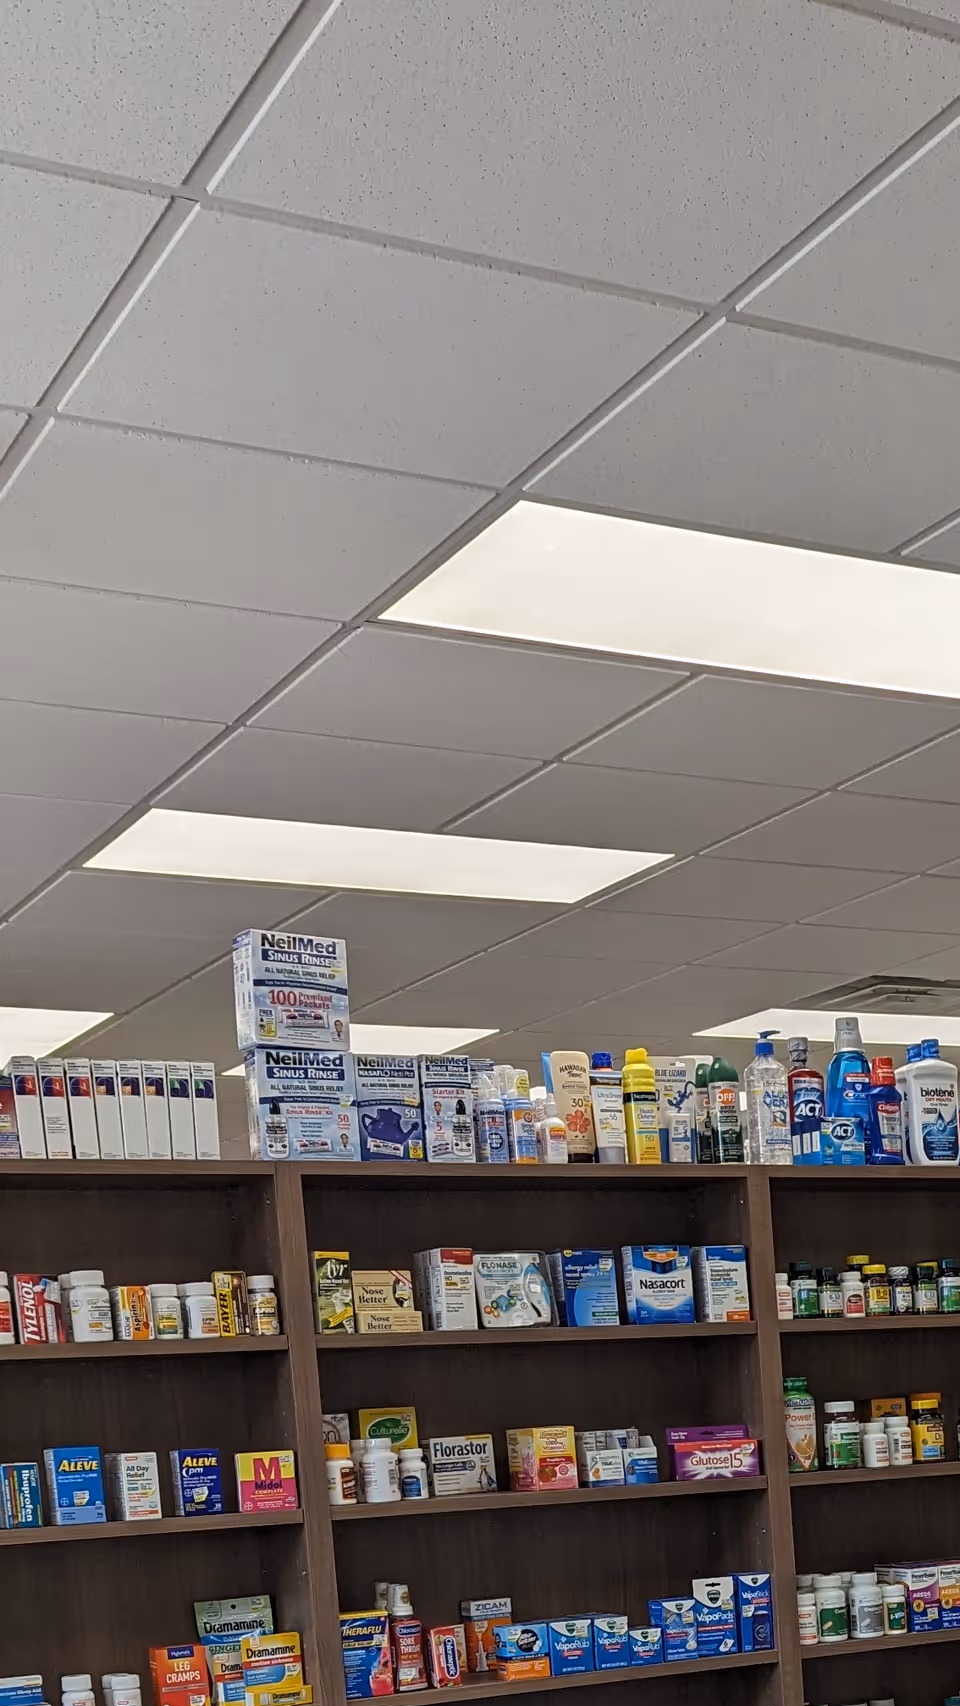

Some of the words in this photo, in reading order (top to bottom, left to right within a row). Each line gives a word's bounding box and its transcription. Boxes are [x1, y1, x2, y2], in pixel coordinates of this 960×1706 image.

[261, 934, 336, 955] NeilMed
[268, 951, 298, 963] SINUS
[301, 954, 331, 967] RINSE
[268, 990, 297, 1006] 100
[299, 992, 332, 1003] Premixed
[299, 1000, 330, 1009] Packets
[265, 1051, 344, 1067] NeilMed
[357, 1056, 414, 1068] NeilMed
[425, 1056, 468, 1066] NeilMed
[273, 1068, 305, 1079] SINUS
[308, 1069, 339, 1079] RINSE
[359, 1069, 390, 1078] NASAFLO
[560, 1064, 586, 1073] HAWAIIAN
[655, 1069, 667, 1077] BLUE
[669, 1069, 687, 1078] LIZARD
[716, 1092, 735, 1102] OFF!
[920, 1087, 954, 1098] biotène
[571, 1098, 585, 1108] 30
[405, 1109, 417, 1118] 50
[797, 1104, 823, 1116] ACT
[337, 1114, 349, 1123] 50
[436, 1121, 443, 1131] 5
[833, 1127, 855, 1139] ACT
[321, 1258, 348, 1279] Ayr
[482, 1261, 518, 1270] FLONASE
[640, 1279, 686, 1290] Nasacort
[362, 1286, 385, 1296] Nose
[359, 1295, 388, 1305] Better
[24, 1281, 41, 1342] TYLENOL
[132, 1292, 143, 1332] Aspirin
[219, 1290, 231, 1334] BAYER
[371, 1315, 391, 1323] Nose
[367, 1322, 393, 1331] Better
[433, 1442, 488, 1458] Florastor
[182, 1456, 218, 1467] ALEVE
[690, 1453, 730, 1466] Glutose
[58, 1459, 99, 1472] ALEVE
[137, 1465, 149, 1474] Day
[188, 1467, 203, 1475] pm
[253, 1457, 281, 1480] M
[255, 1480, 283, 1490] Midol
[20, 1470, 33, 1522] Ibuprofen
[475, 1600, 508, 1611] ZICAM
[697, 1611, 734, 1624] VapoPads
[204, 1618, 265, 1634] Dramamine
[342, 1625, 382, 1636] THERAFLU
[400, 1637, 415, 1646] SORE
[555, 1640, 589, 1651] VapoRub
[598, 1635, 628, 1645] VapoRub
[246, 1645, 296, 1659] Dramamine
[633, 1642, 660, 1653] VapoRub
[174, 1661, 191, 1672] LEG
[166, 1670, 200, 1682] CRAMPS
